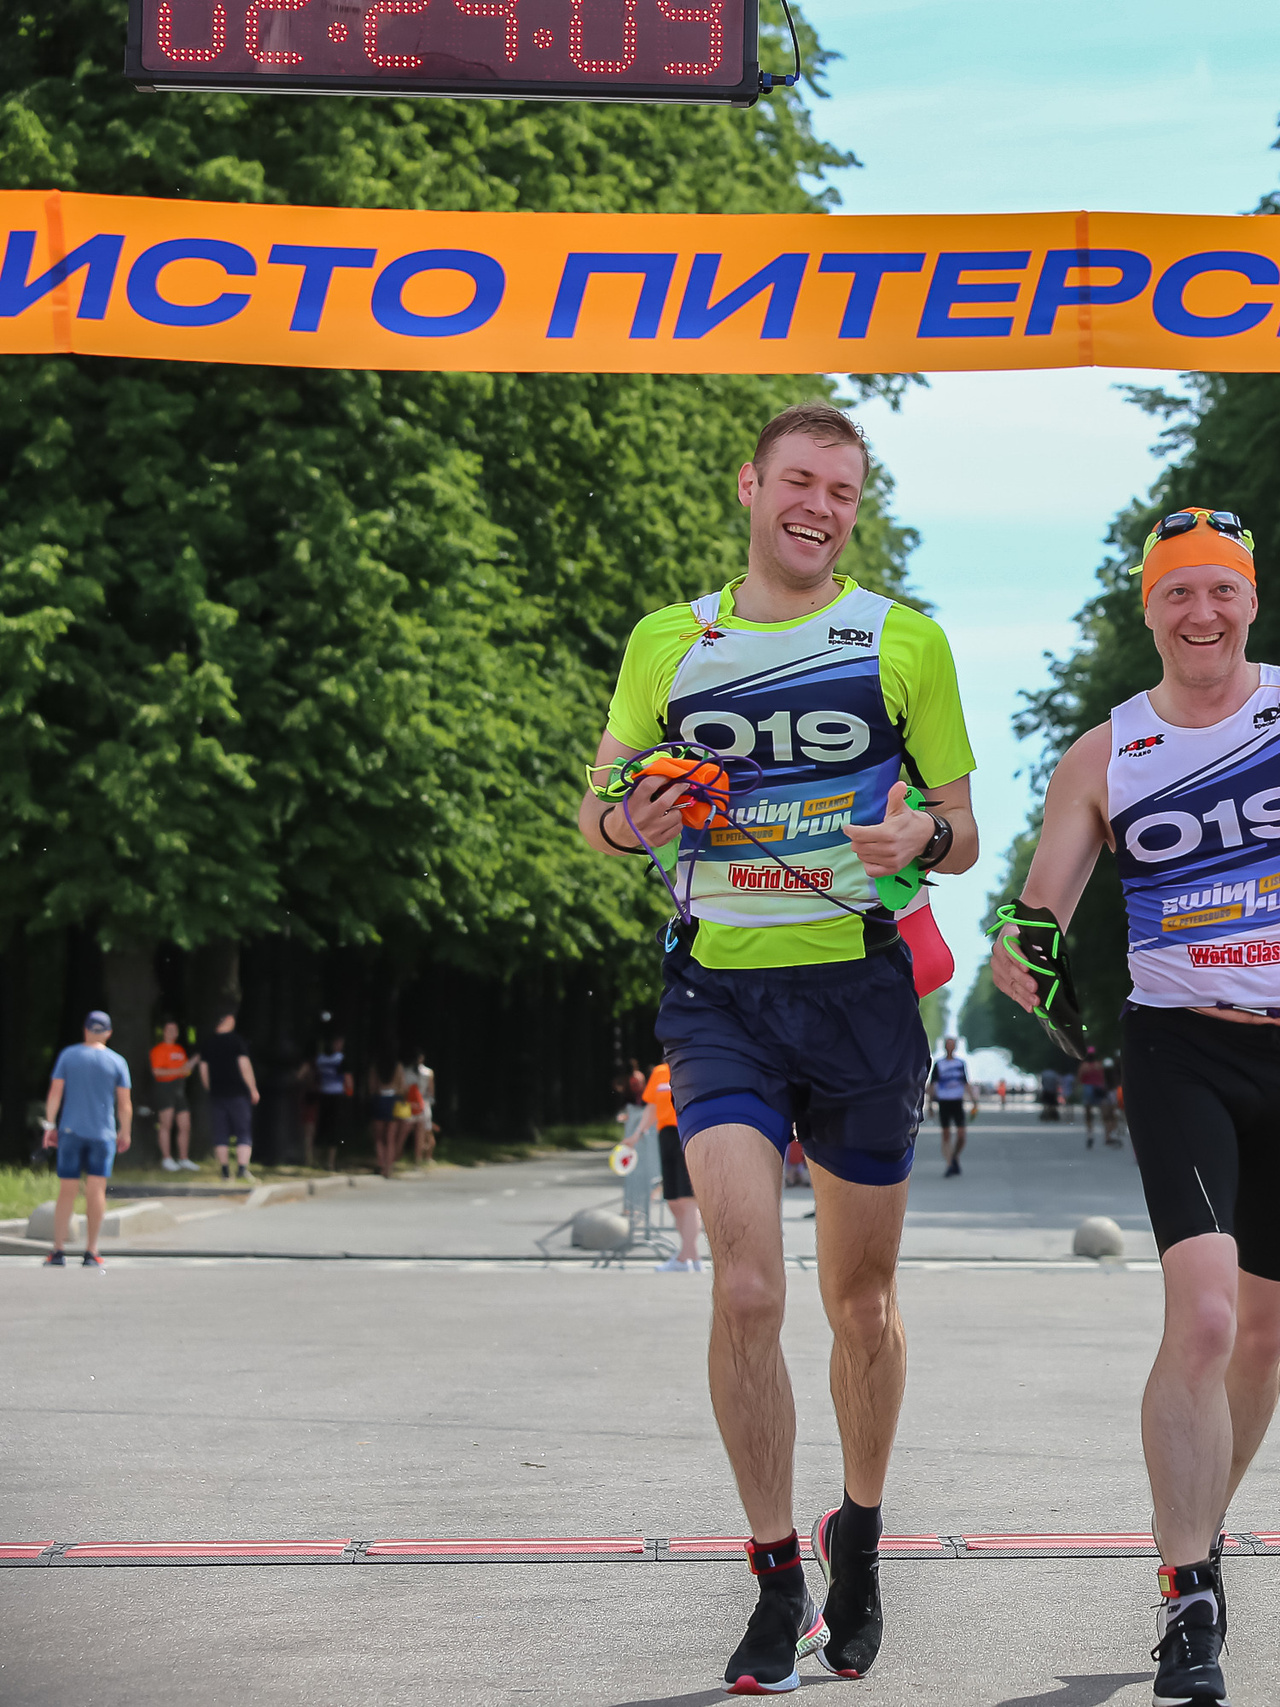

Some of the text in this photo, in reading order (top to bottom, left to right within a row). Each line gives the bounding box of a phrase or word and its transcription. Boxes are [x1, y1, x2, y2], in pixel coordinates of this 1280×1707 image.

[680, 710, 870, 762] 019
[807, 796, 849, 812] 4 ISLANDS
[731, 866, 780, 889] World
[1264, 880, 1269, 888] 4
[1179, 908, 1232, 926] PETERSBURG
[1191, 946, 1243, 965] World
